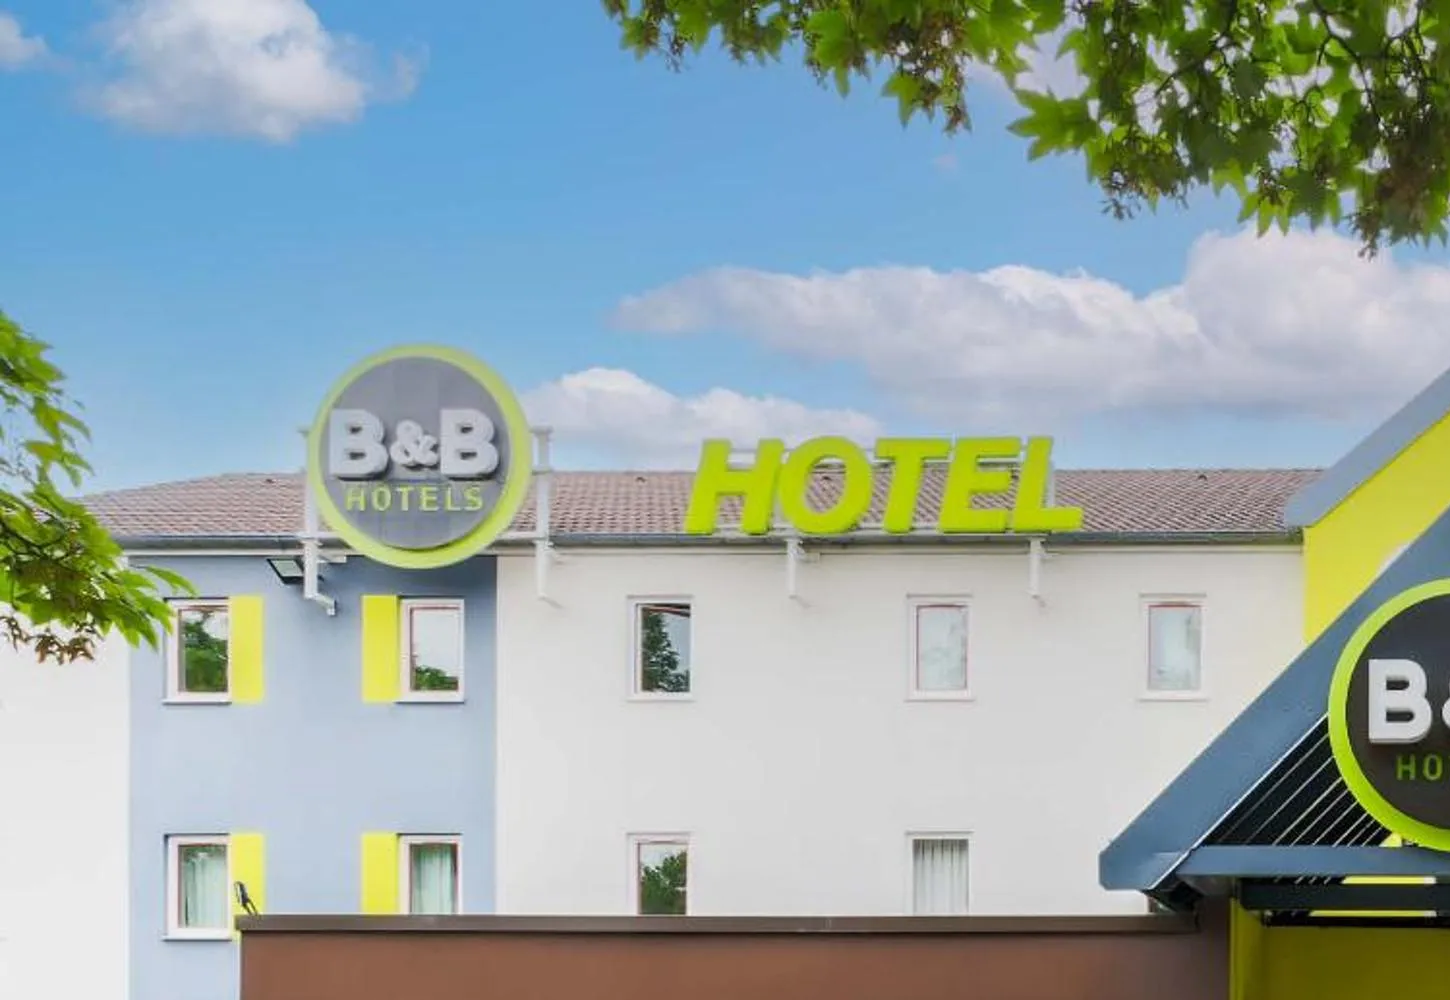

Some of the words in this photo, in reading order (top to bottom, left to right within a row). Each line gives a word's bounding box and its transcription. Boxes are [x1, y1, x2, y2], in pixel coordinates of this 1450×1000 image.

[329, 408, 500, 479] B&B
[346, 484, 484, 512] HOTELS
[684, 435, 1083, 535] HOTEL
